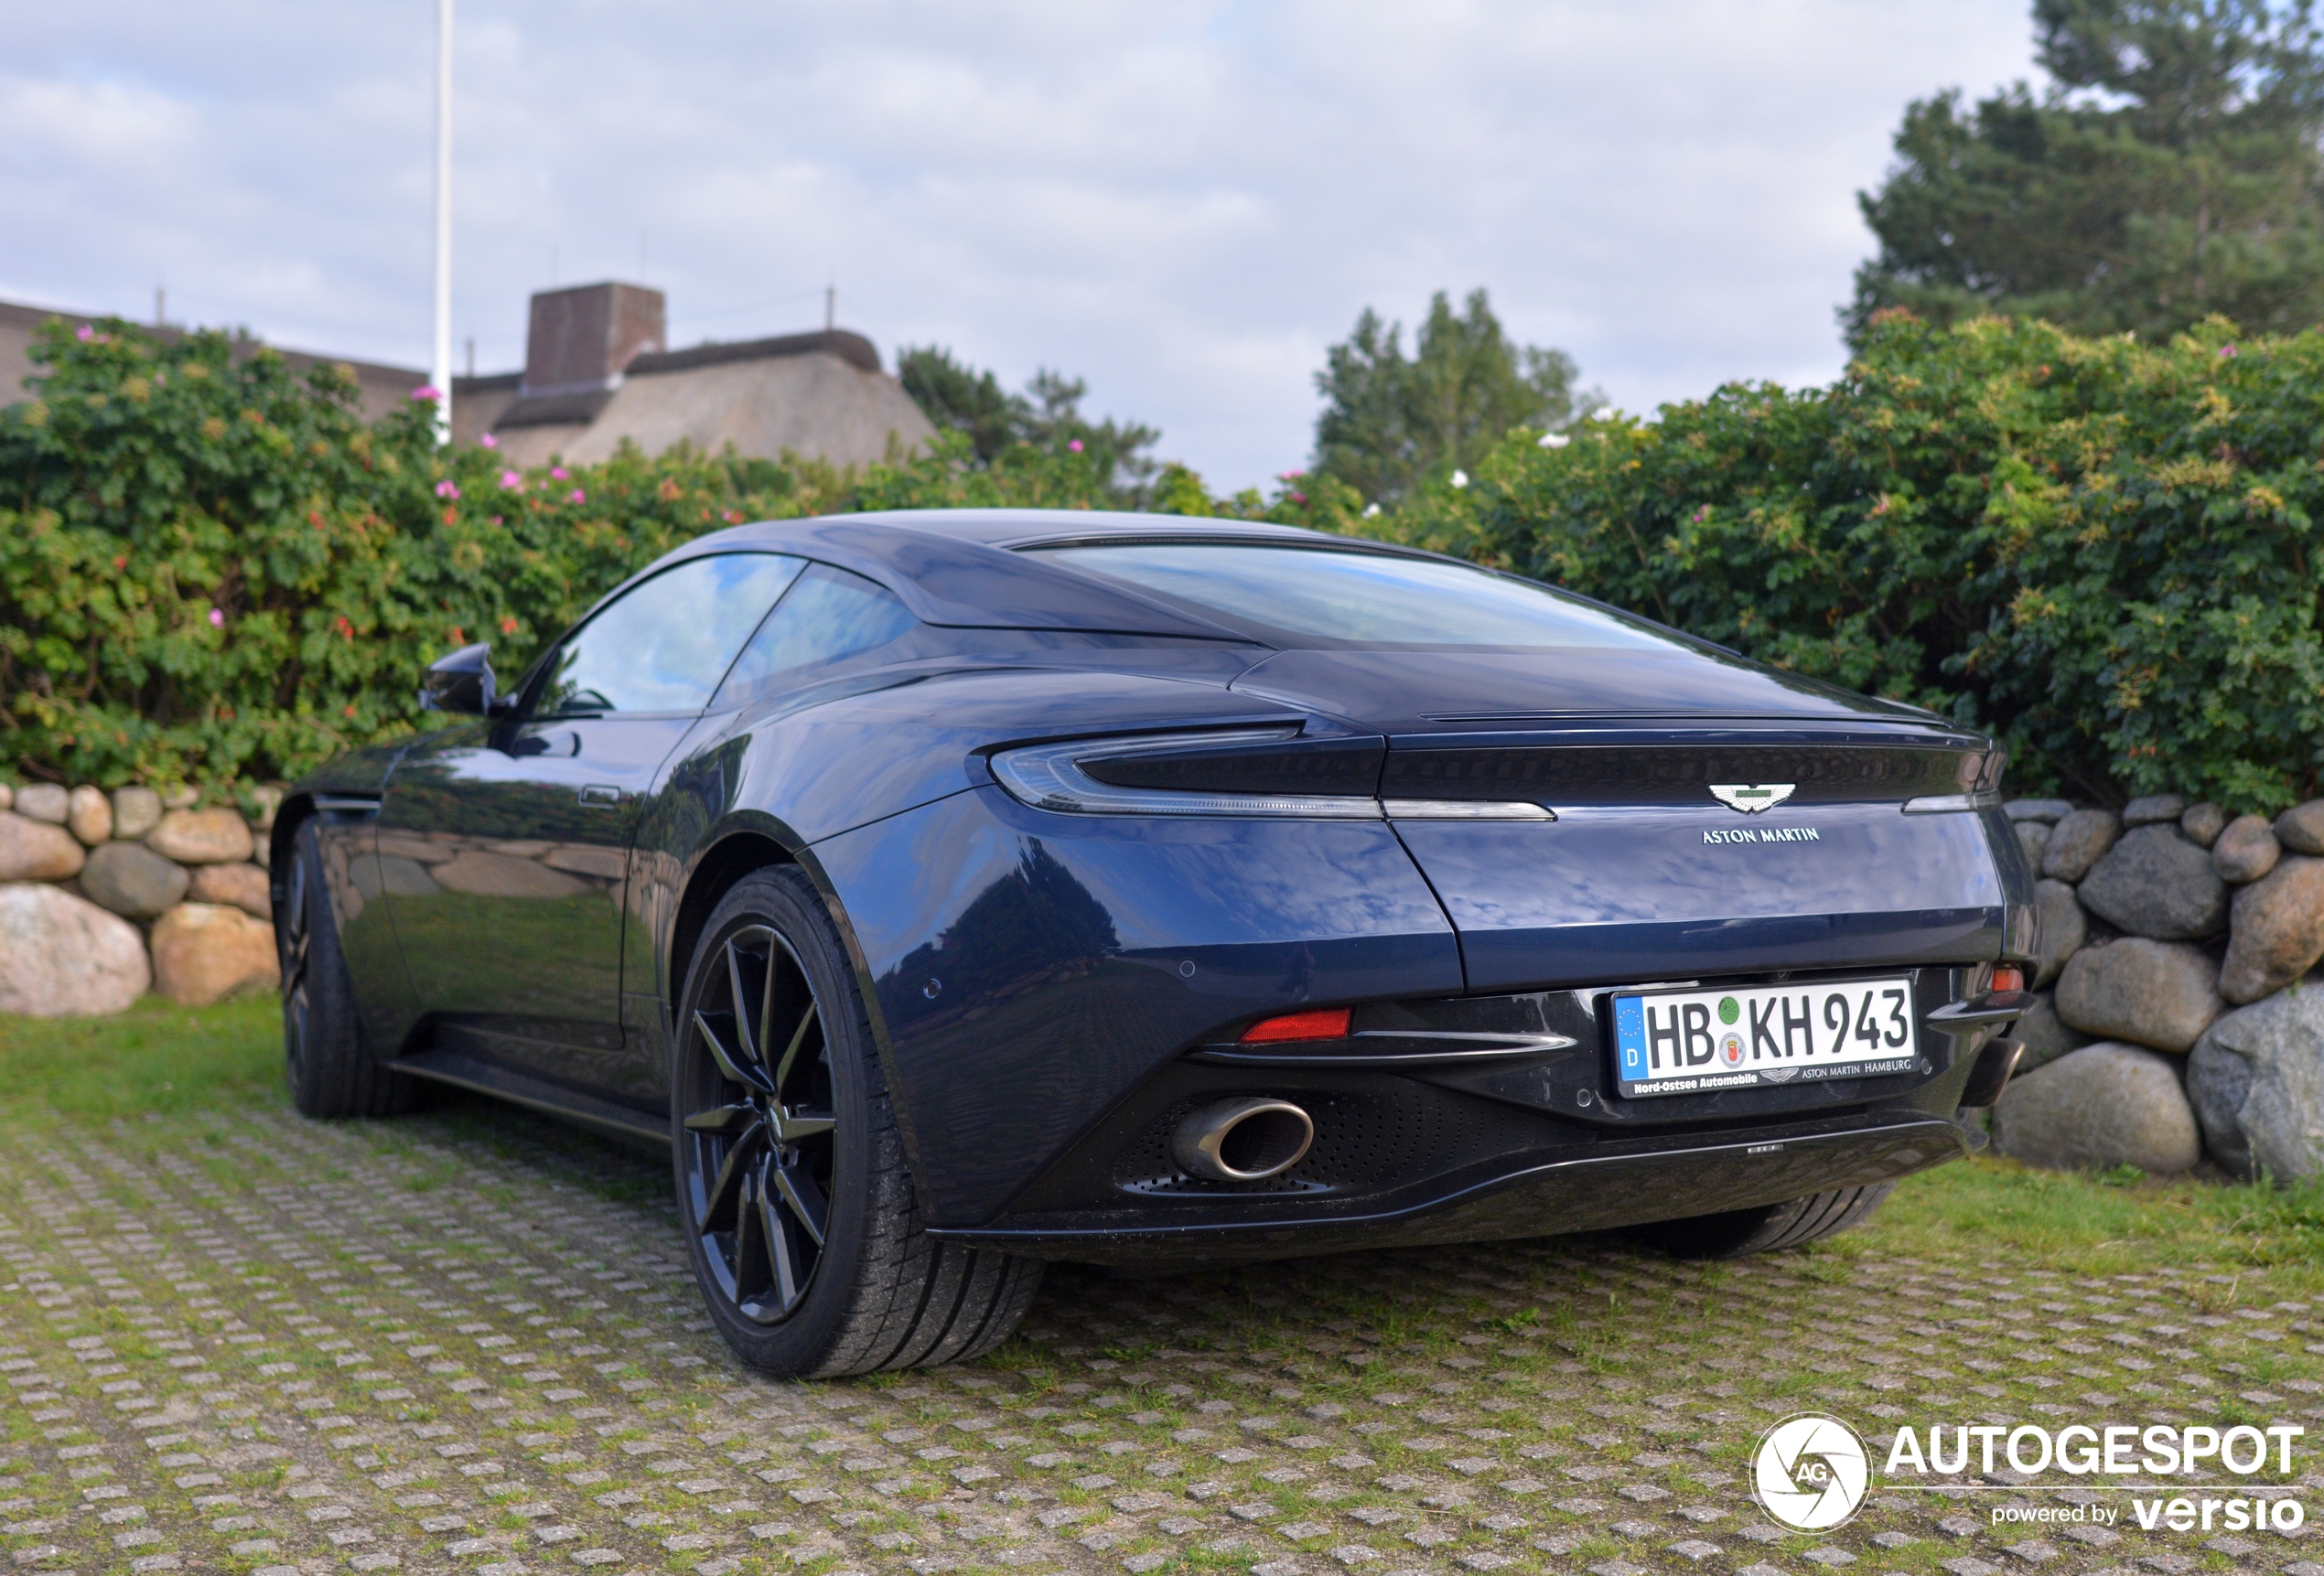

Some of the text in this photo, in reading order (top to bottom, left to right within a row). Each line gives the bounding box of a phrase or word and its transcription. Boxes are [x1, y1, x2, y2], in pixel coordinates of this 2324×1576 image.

[1703, 828, 1819, 845] ASTON MARTIN
[1647, 1002, 1715, 1069] HB
[1748, 995, 1813, 1059] KH
[1824, 988, 1908, 1053] 943
[1627, 1048, 1638, 1067] D
[1802, 1059, 1911, 1078] ASTON MARTIN HAMBURG
[1634, 1073, 1758, 1095] Nord-Ostsee Automobile
